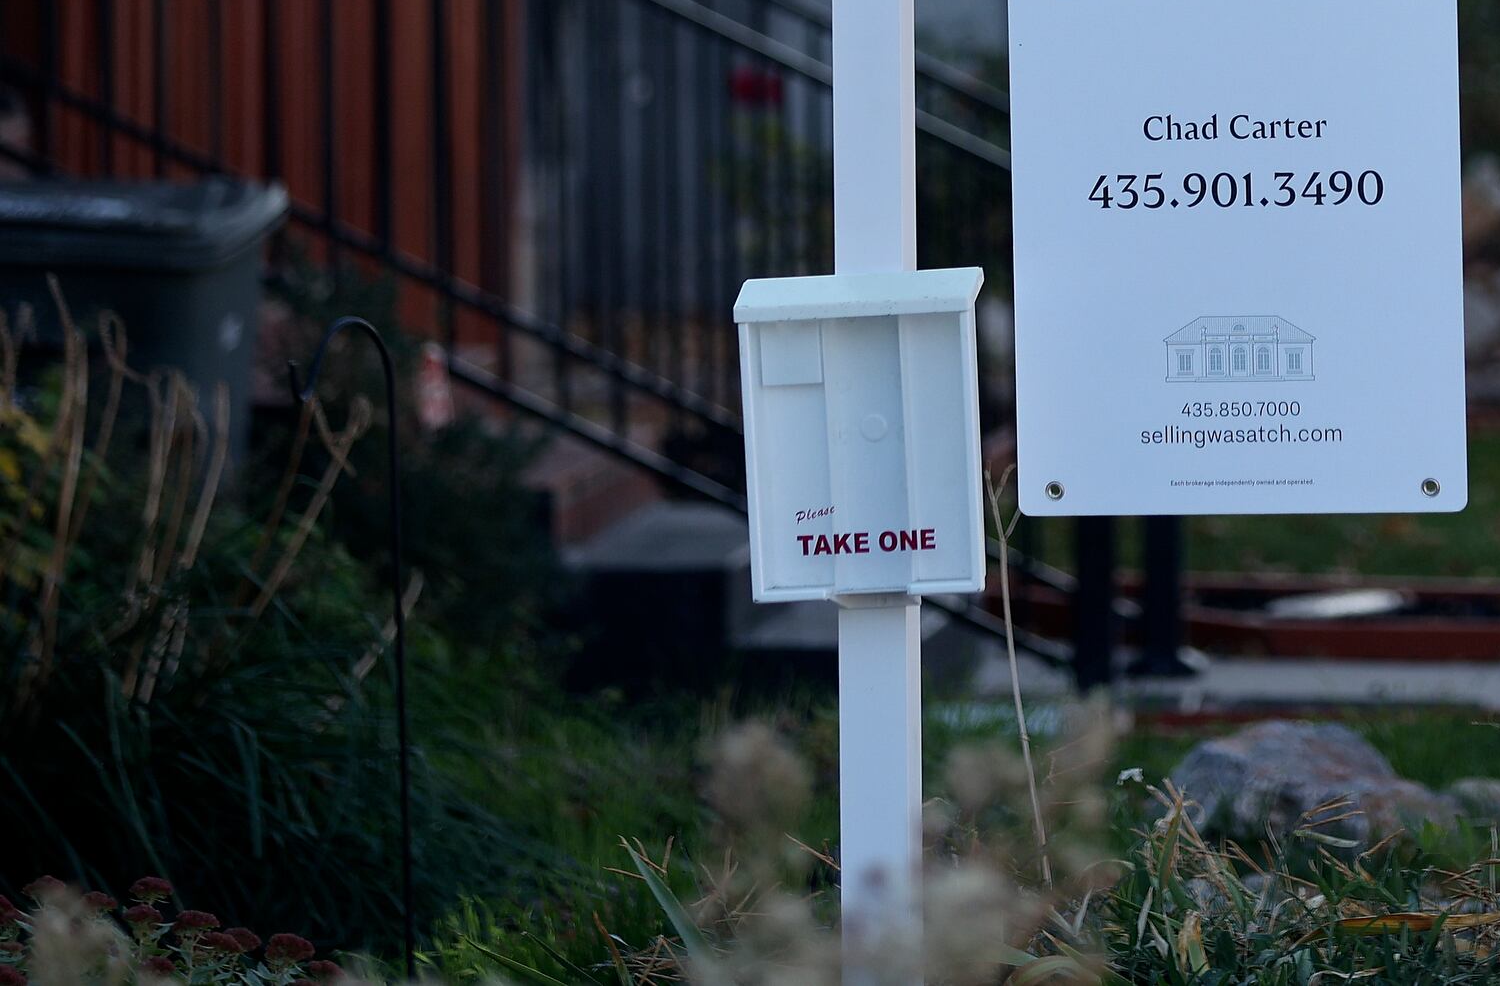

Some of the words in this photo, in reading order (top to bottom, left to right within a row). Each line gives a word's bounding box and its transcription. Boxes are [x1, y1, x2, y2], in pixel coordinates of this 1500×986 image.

[1143, 114, 1219, 141] Chad
[1229, 114, 1328, 140] Carter
[1088, 170, 1384, 210] 435.901.3490
[1181, 400, 1301, 418] 435.850.7000
[1140, 424, 1343, 449] sellingwasatch.com
[1185, 480, 1215, 488] brokerage
[1215, 479, 1255, 488] independently
[1275, 478, 1287, 486] and
[795, 504, 836, 525] Please
[796, 532, 870, 556] TAKE
[878, 528, 936, 552] ONE
